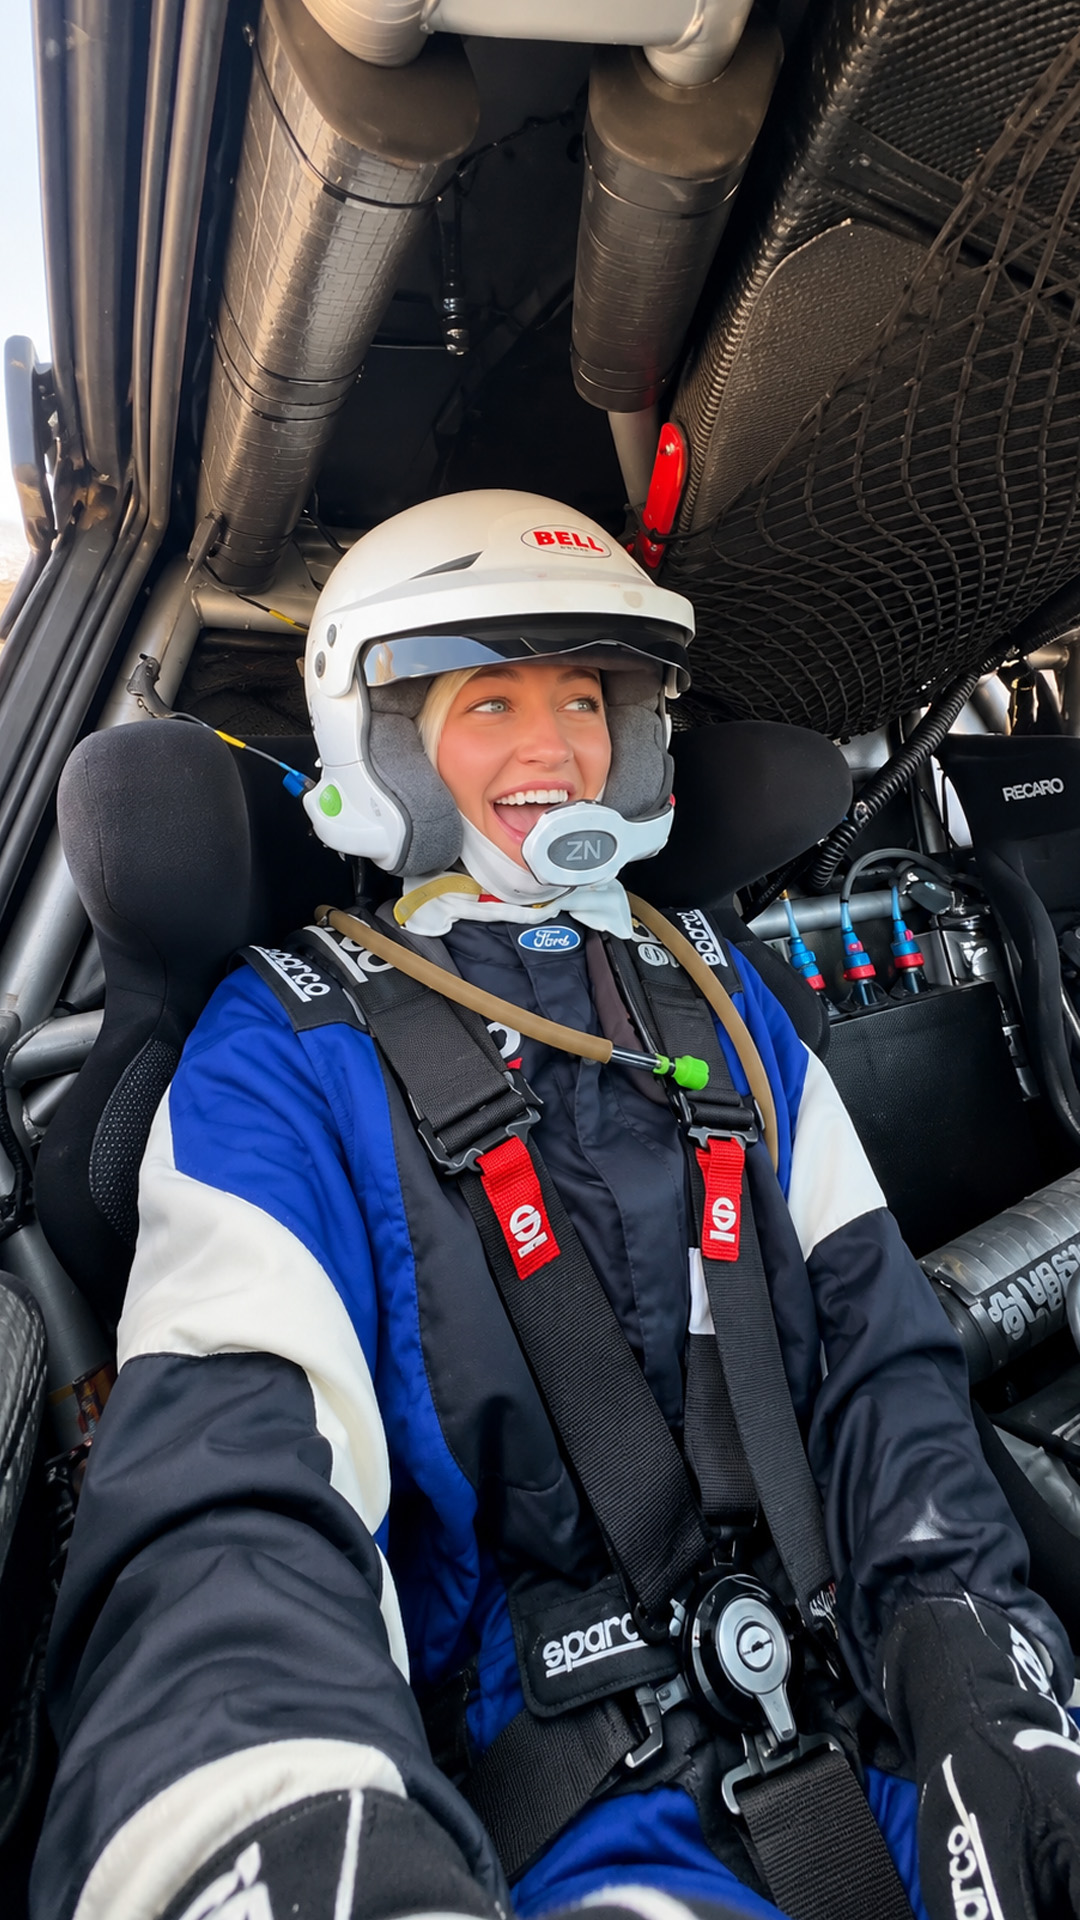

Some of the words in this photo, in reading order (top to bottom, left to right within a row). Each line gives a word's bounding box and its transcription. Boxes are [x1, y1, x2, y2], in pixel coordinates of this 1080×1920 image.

[533, 531, 604, 553] BELL
[1002, 777, 1065, 802] RECARO
[566, 840, 601, 862] ZN
[533, 929, 571, 948] Ford
[255, 946, 331, 996] parco
[542, 1612, 640, 1673] sparc
